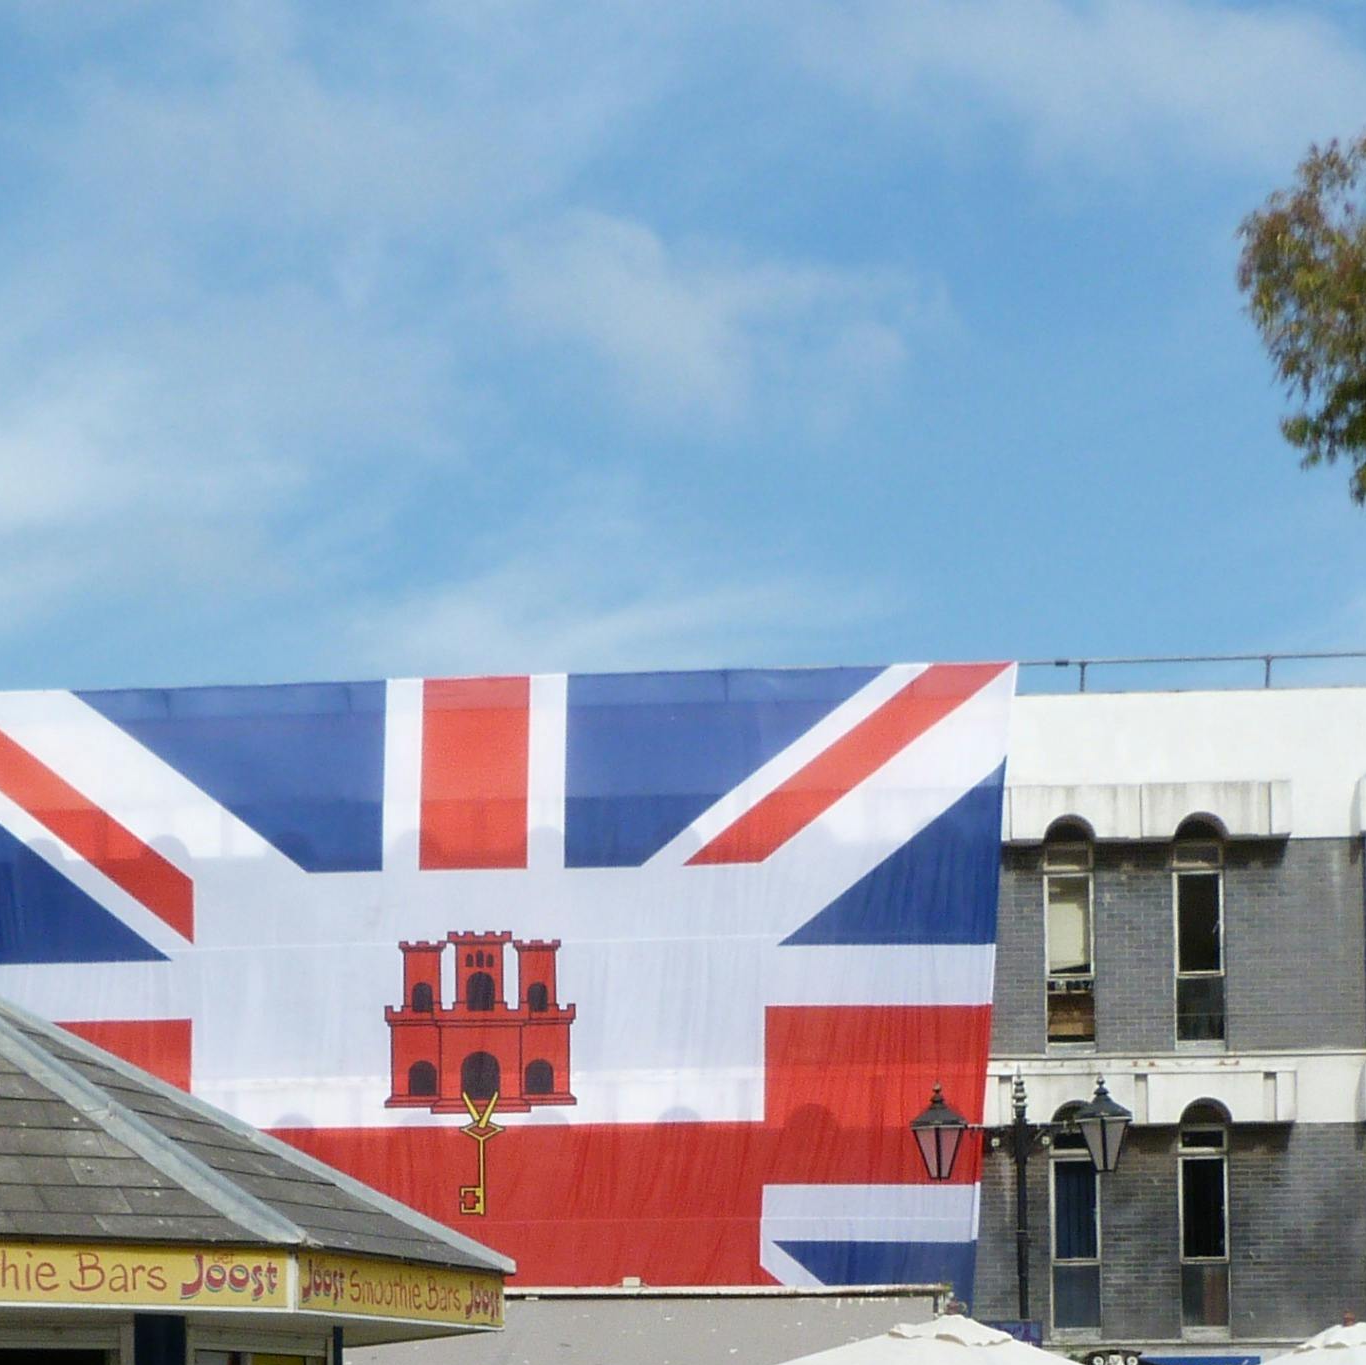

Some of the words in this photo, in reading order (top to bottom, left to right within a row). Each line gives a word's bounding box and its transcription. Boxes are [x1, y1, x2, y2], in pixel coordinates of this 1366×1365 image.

[69, 1252, 167, 1292] Bars
[180, 1253, 278, 1300] Joost
[302, 1258, 345, 1304] Joost
[349, 1268, 421, 1310] Smoothie
[426, 1275, 461, 1312] Bars
[465, 1280, 500, 1321] Joost
